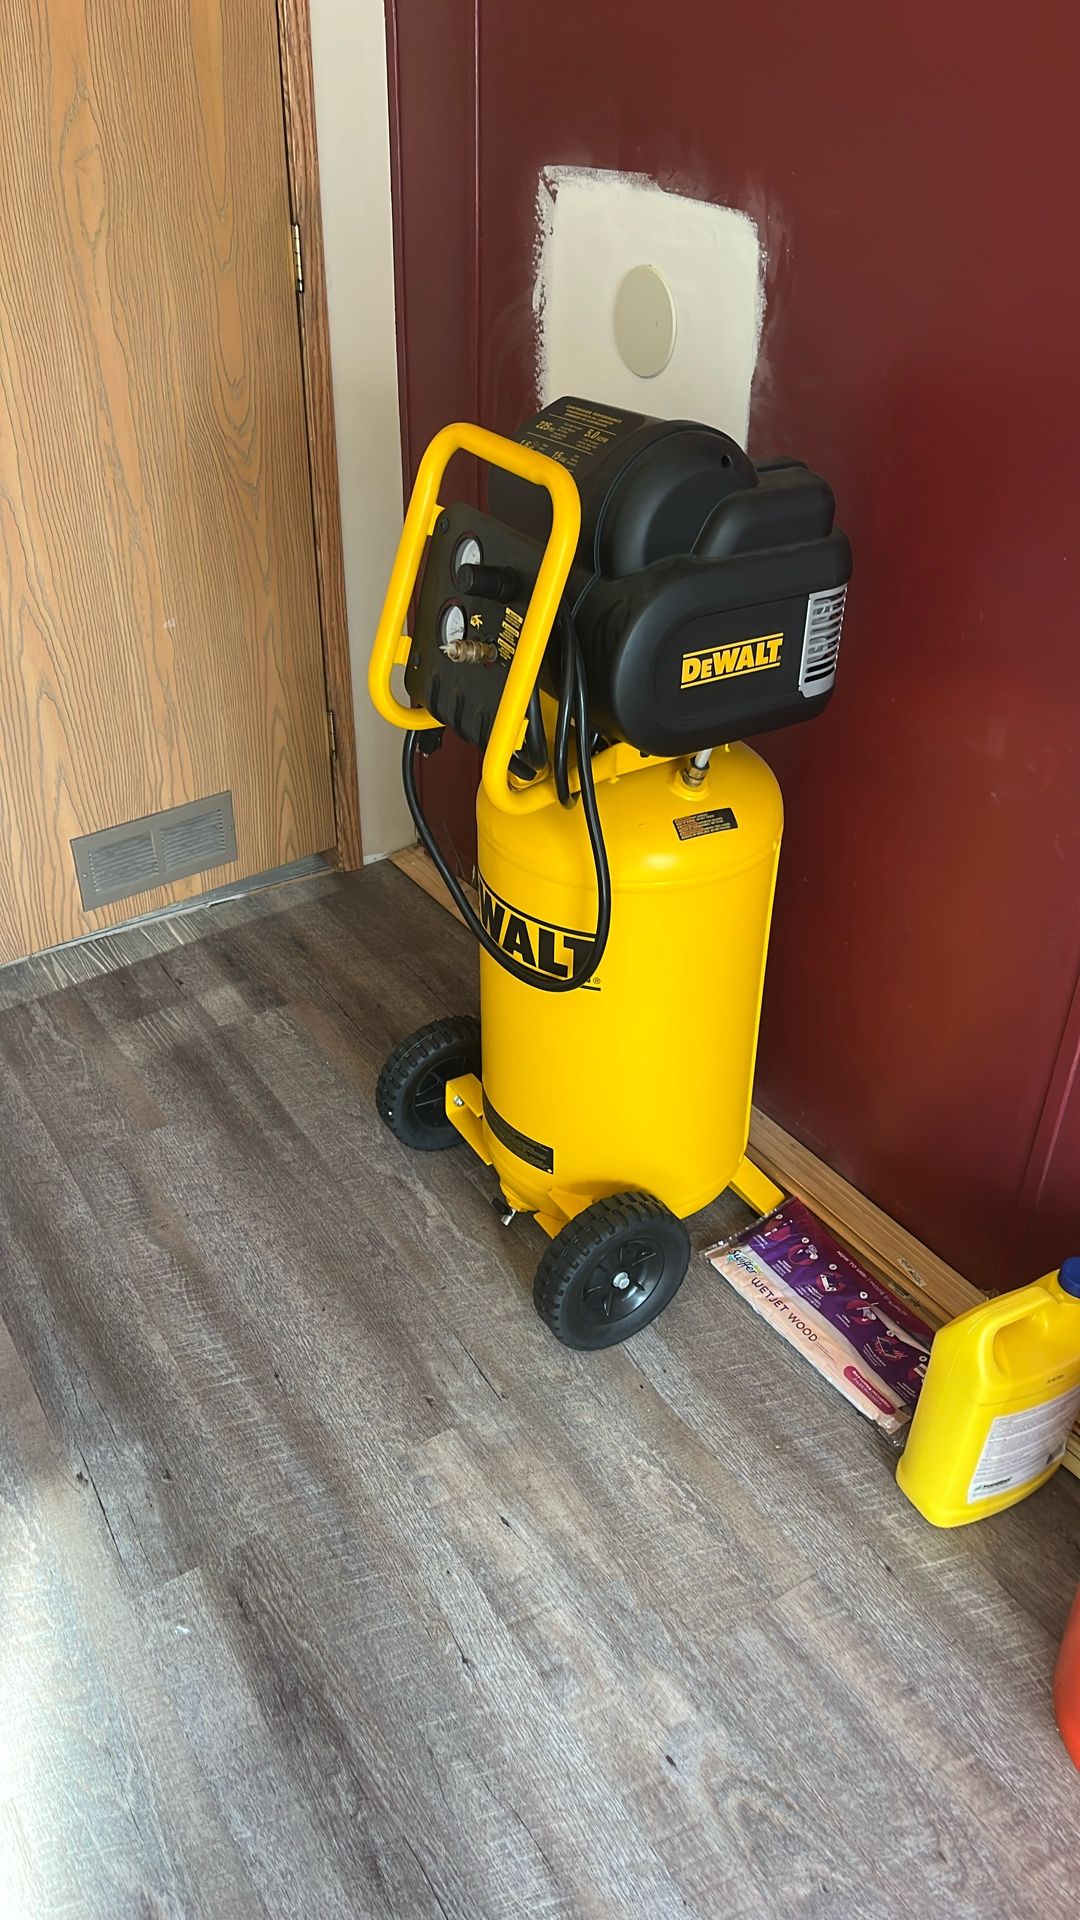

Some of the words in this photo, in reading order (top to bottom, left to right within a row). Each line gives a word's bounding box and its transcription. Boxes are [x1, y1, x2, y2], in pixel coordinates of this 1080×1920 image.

[535, 420, 552, 431] 225
[583, 429, 601, 440] 5.0
[551, 451, 564, 460] 15
[727, 1248, 758, 1275] Swiffer
[750, 1276, 789, 1314] WETJET
[787, 1312, 818, 1342] WOOD
